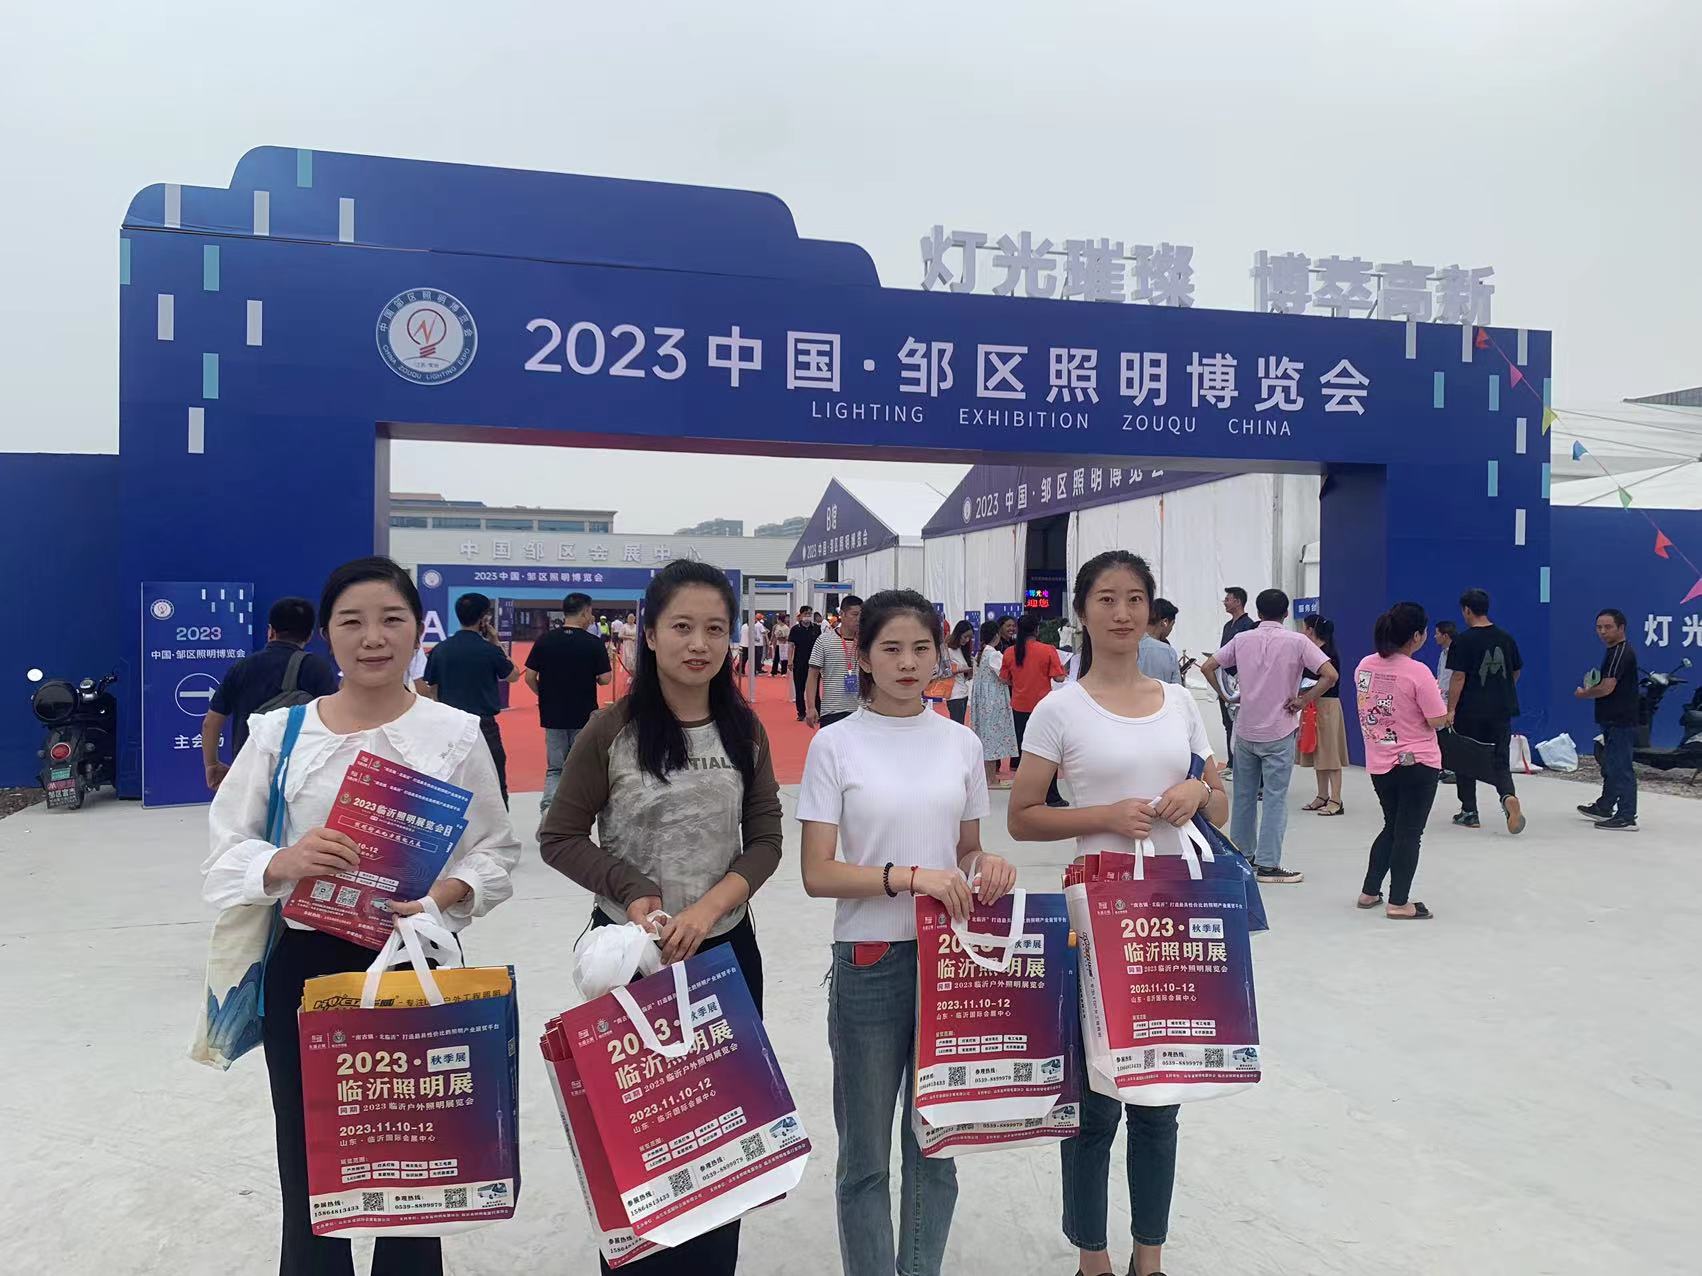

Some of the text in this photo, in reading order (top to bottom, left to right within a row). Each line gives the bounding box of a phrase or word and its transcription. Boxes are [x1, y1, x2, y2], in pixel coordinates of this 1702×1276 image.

[920, 225, 1495, 325] 灯光璀璨 博萃高新
[811, 401, 1292, 437] LIGHTING EXHIBITION ZOUQU CHINA
[459, 539, 702, 562] 中国邹区会展中心
[1024, 598, 1050, 608] 迎您
[176, 627, 222, 641] 2023
[151, 648, 246, 660] 中国·邹区照明博览会
[1191, 923, 1222, 933] 秋季展
[1123, 941, 1228, 963] 临沂照明展
[1130, 983, 1195, 994] 2023.11.10-12
[936, 999, 1011, 1011] 2023.11.10-12
[606, 1017, 681, 1065] 203·
[430, 1052, 466, 1066] 秋季展
[614, 1018, 734, 1090] 临沂明展
[337, 1072, 474, 1103] 临沂照明展
[629, 1077, 712, 1125] 2023.11.10-12
[633, 1089, 717, 1134] 山东·临沂国际会展中心
[339, 1122, 434, 1137] 2023.11.10-12
[339, 1134, 436, 1147] 山东·临沂国际会展中心
